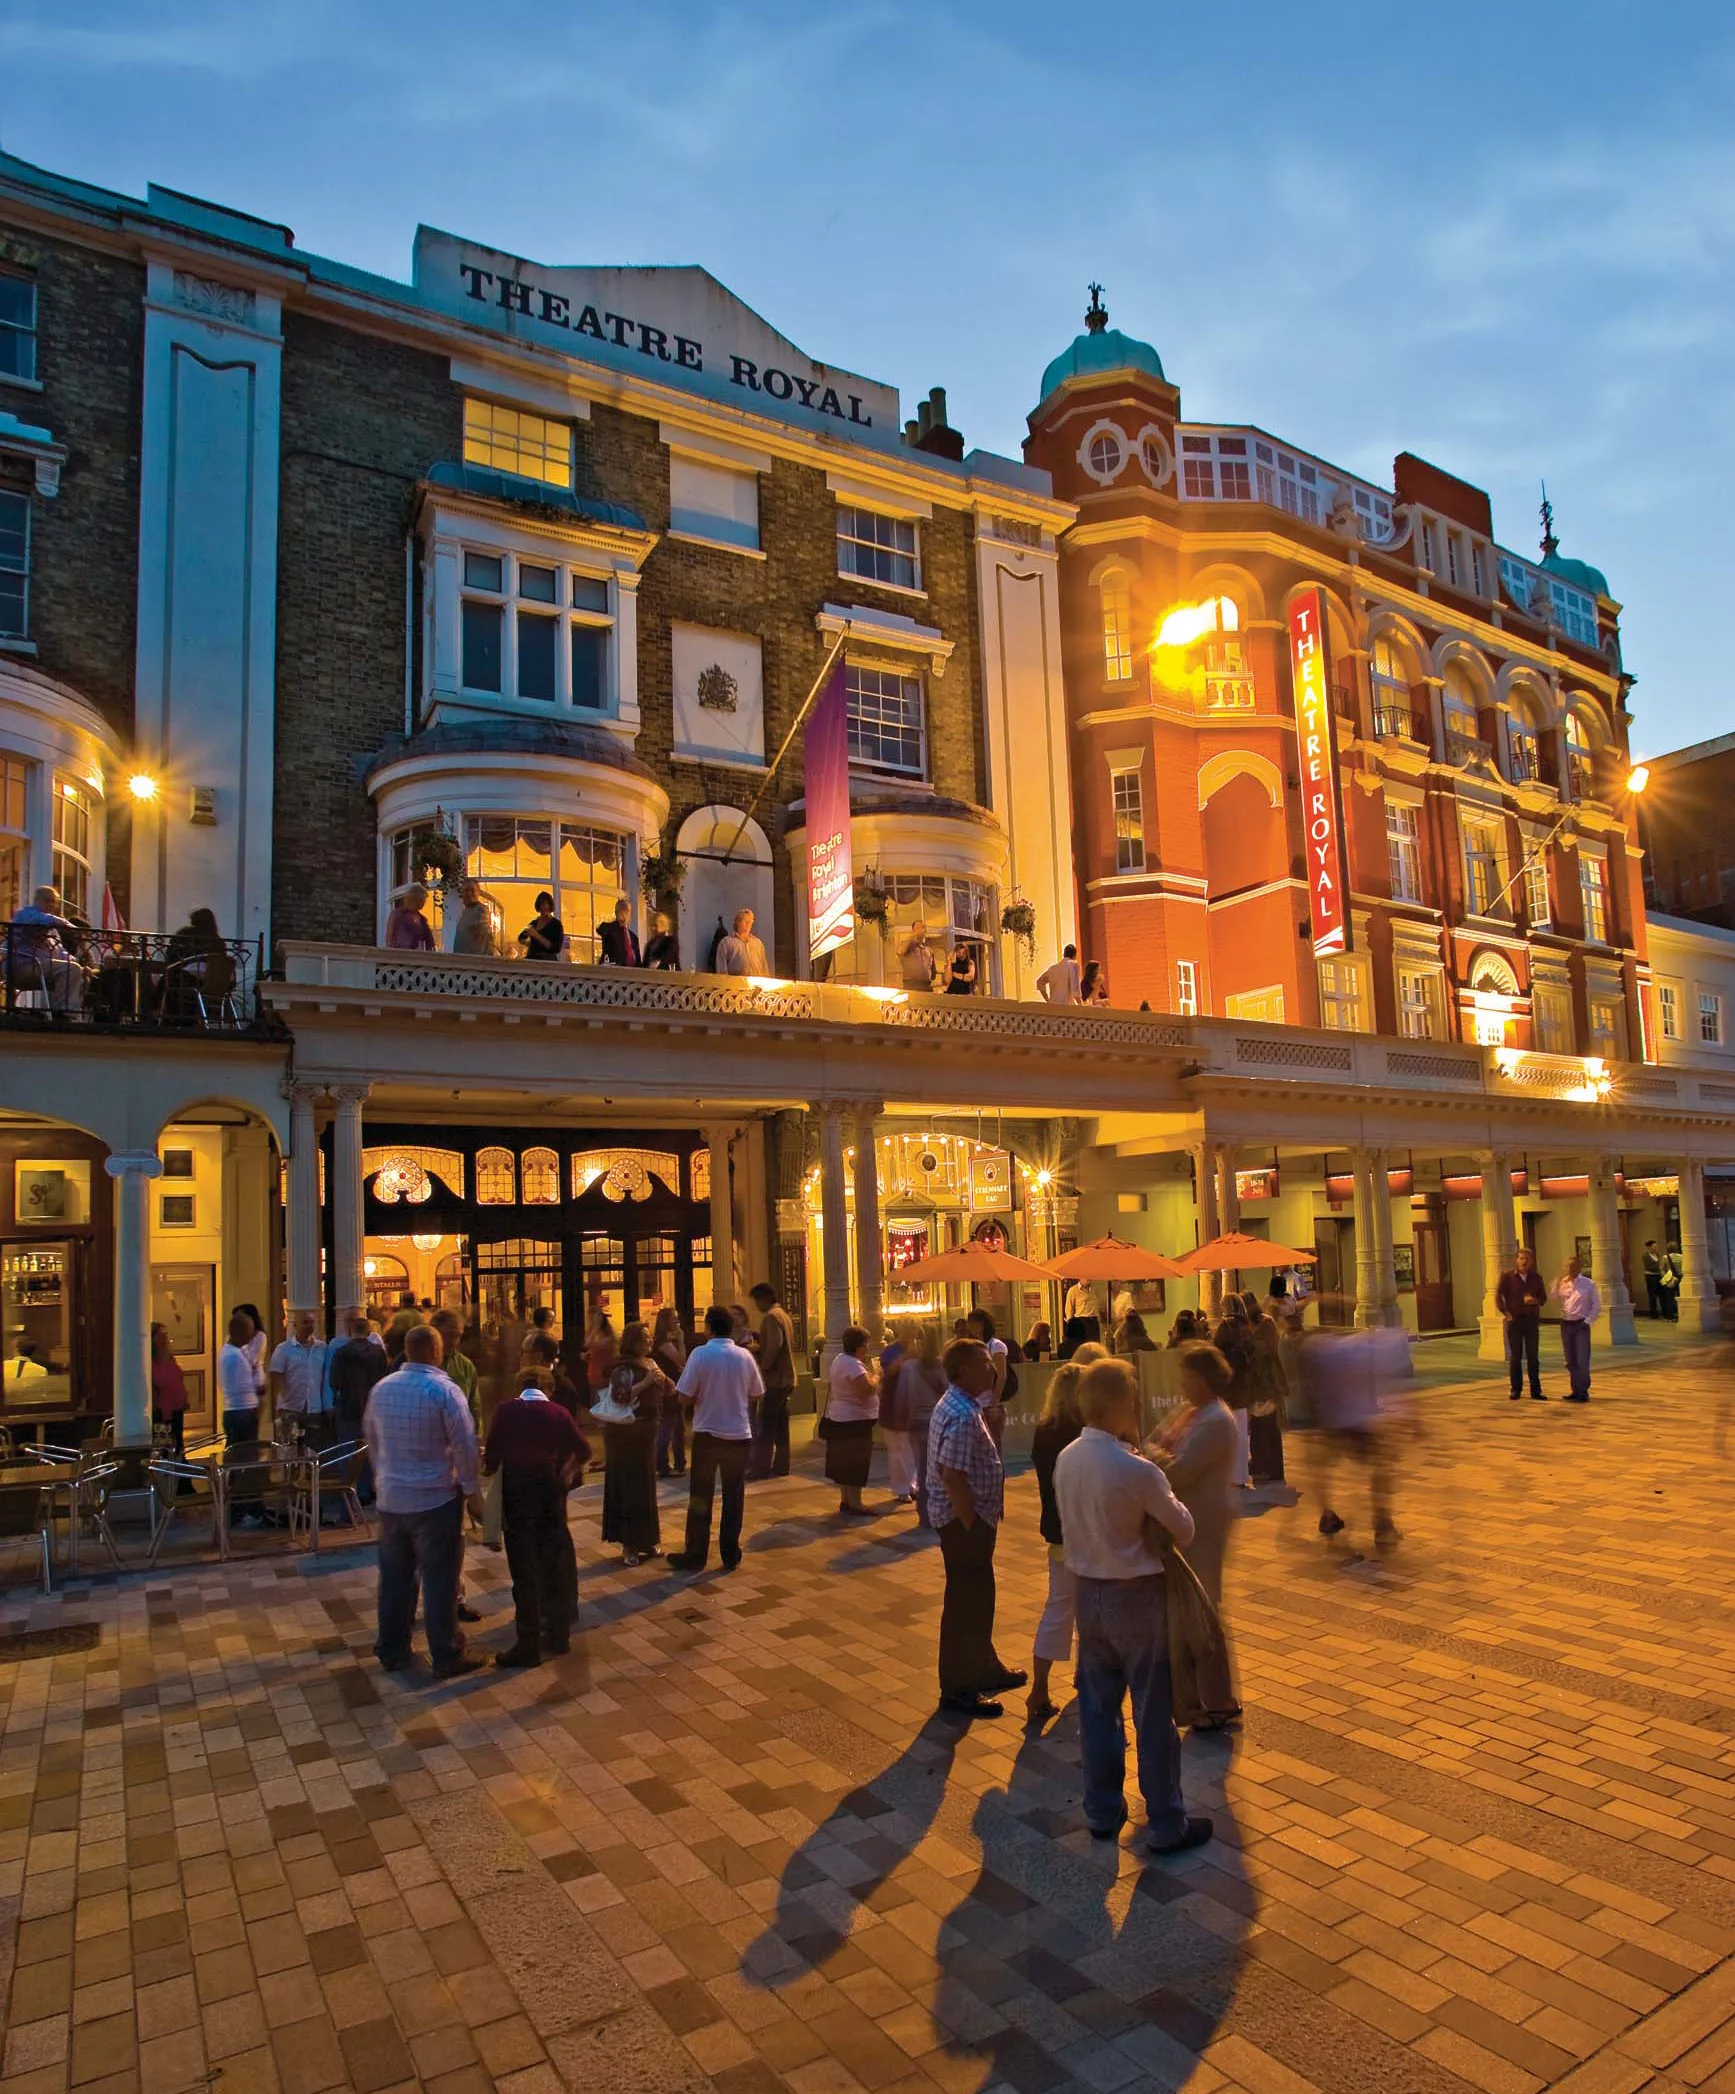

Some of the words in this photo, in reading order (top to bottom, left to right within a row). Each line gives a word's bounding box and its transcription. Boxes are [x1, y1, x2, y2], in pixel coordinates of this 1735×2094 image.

[460, 263, 702, 372] THEATRE
[729, 355, 872, 428] ROYAL
[1296, 609, 1321, 782] THEATRE
[1311, 793, 1333, 918] ROYAL
[811, 832, 843, 860] Theatre
[811, 855, 835, 881] Royal
